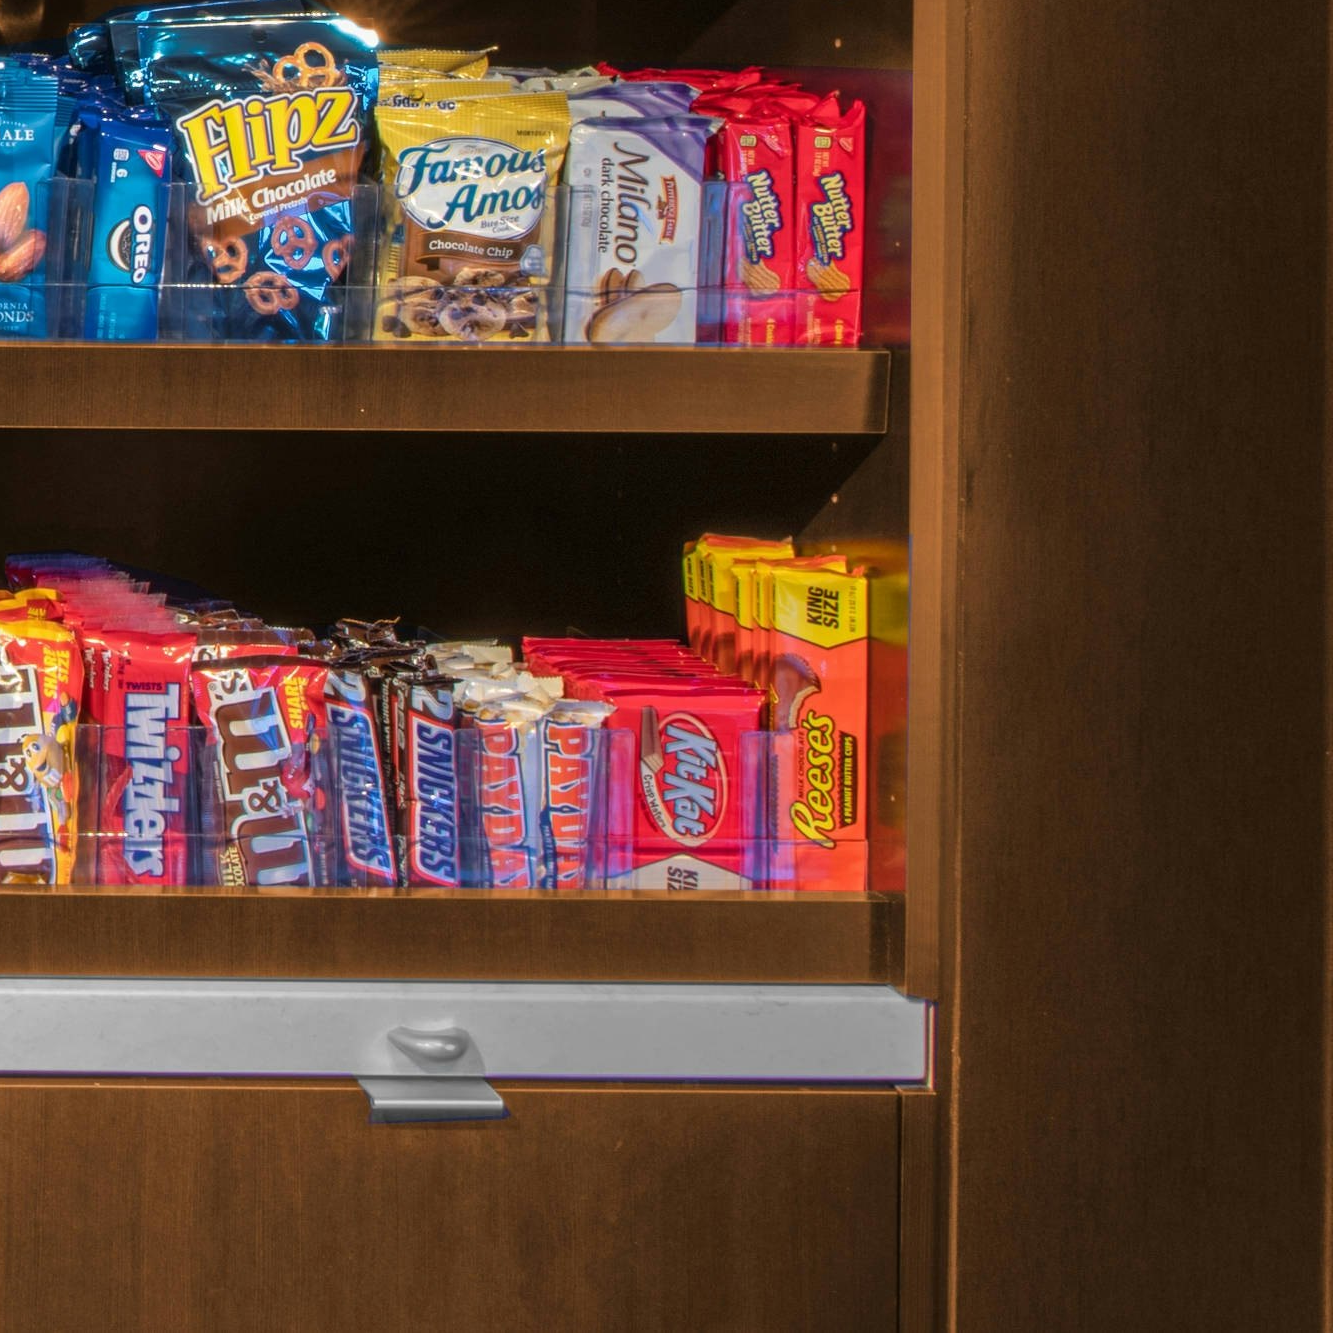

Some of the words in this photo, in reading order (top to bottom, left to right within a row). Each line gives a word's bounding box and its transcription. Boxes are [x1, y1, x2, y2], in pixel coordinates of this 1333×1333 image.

[179, 88, 359, 204] Flipz
[395, 144, 546, 199] Famous
[206, 196, 250, 226] Milk
[251, 169, 337, 211] Chocolate
[426, 183, 546, 229] Amos
[600, 157, 615, 227] dark
[613, 141, 652, 264] Milano
[747, 169, 780, 229] Nutter
[820, 173, 852, 232] Nutter
[132, 204, 154, 285] OREO
[429, 239, 484, 255] Chocolate
[486, 247, 514, 260] Chip
[598, 230, 614, 254] chocolate
[743, 201, 772, 257] Butter
[812, 203, 843, 260] Butter
[807, 585, 824, 627] KING
[822, 589, 839, 630] SIZE
[43, 647, 59, 700] SHARE
[126, 682, 163, 690] TWISTS
[844, 735, 853, 756] CUPS
[844, 757, 853, 786] BUTTER
[124, 682, 182, 877] Twizzlers
[331, 707, 388, 870] SNICKERS
[416, 723, 457, 882] SNICKERS
[791, 710, 837, 849] Reese's
[844, 786, 853, 816] PEANUT
